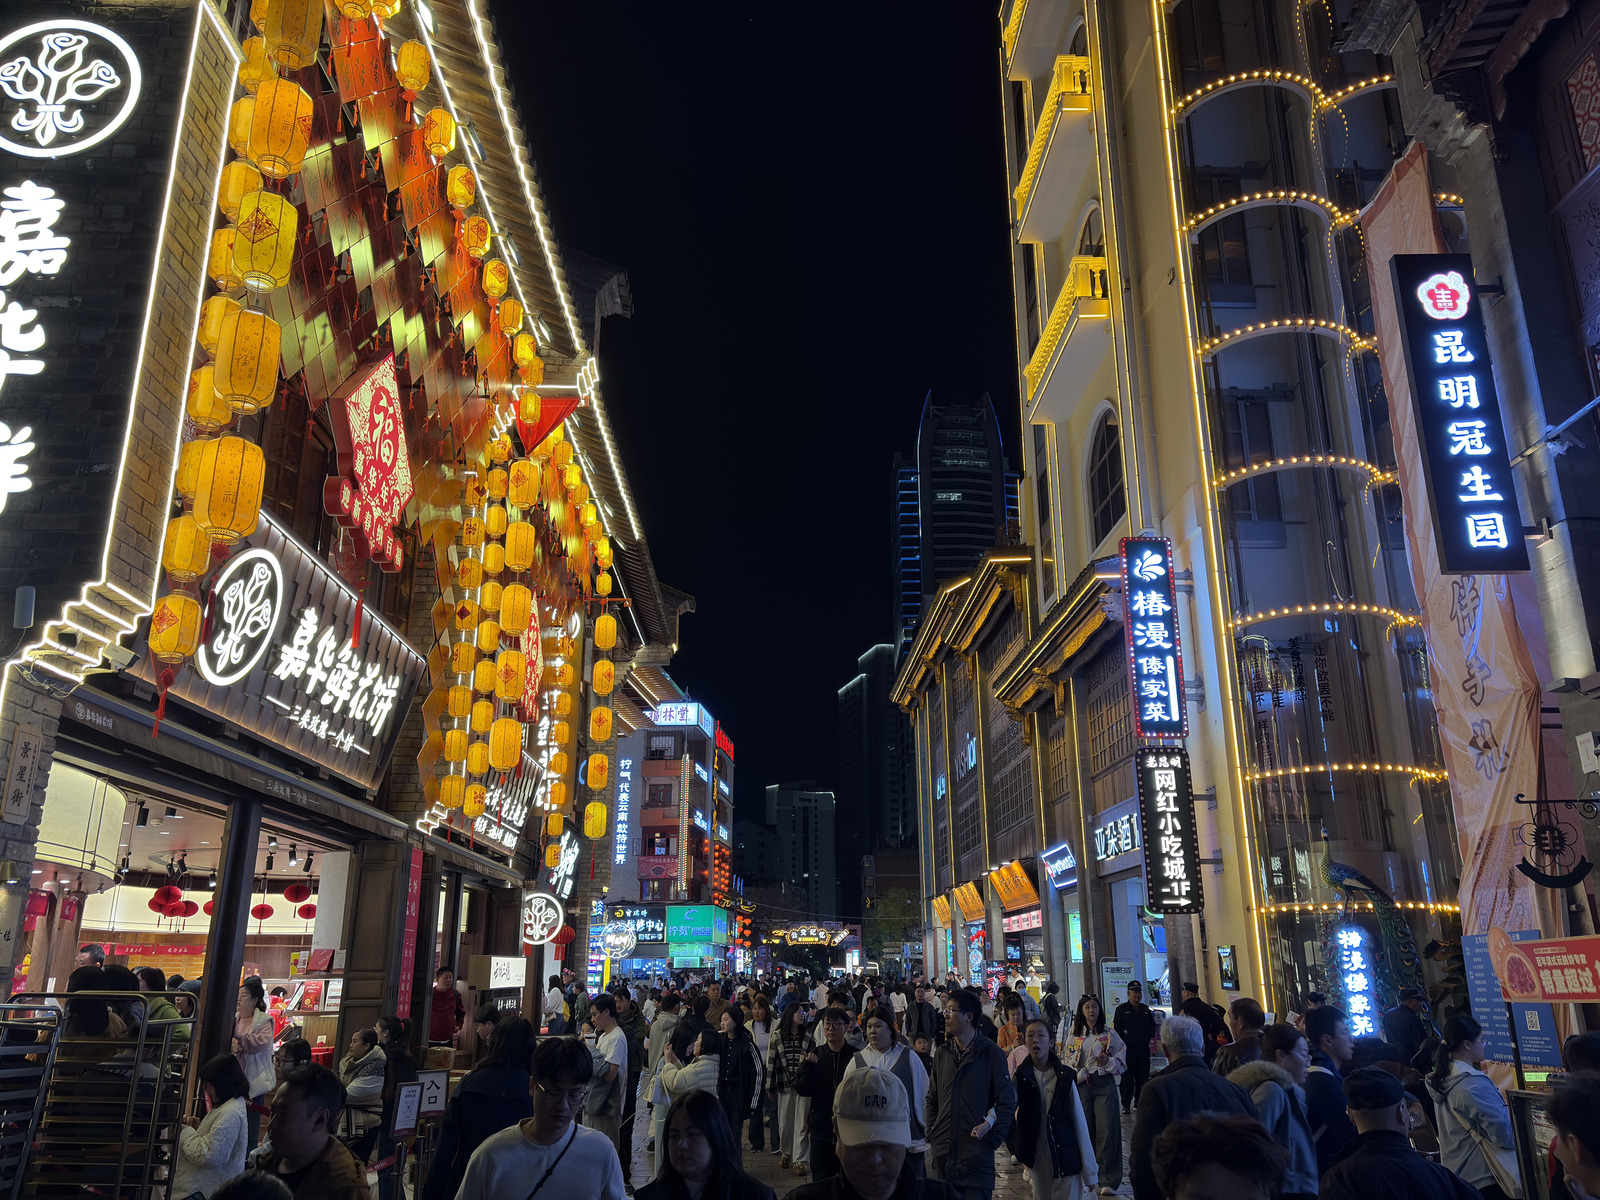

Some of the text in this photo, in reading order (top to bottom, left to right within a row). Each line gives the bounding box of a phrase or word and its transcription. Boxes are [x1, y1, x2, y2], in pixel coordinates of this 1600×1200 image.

[1432, 330, 1510, 551] 昆明冠生园
[274, 607, 400, 737] 嘉华鲜花饼
[1288, 637, 1308, 701] 美食的诱惑
[1313, 644, 1336, 722] 让你欲罢不能
[11, 741, 31, 807] 景星街
[1145, 756, 1182, 769] 老昆明
[1154, 769, 1187, 880] 网红小吃城
[1161, 882, 1192, 896] -1F
[790, 928, 826, 939] 公交记忆
[426, 1080, 441, 1105] 入口
[864, 1093, 888, 1108] CAP
